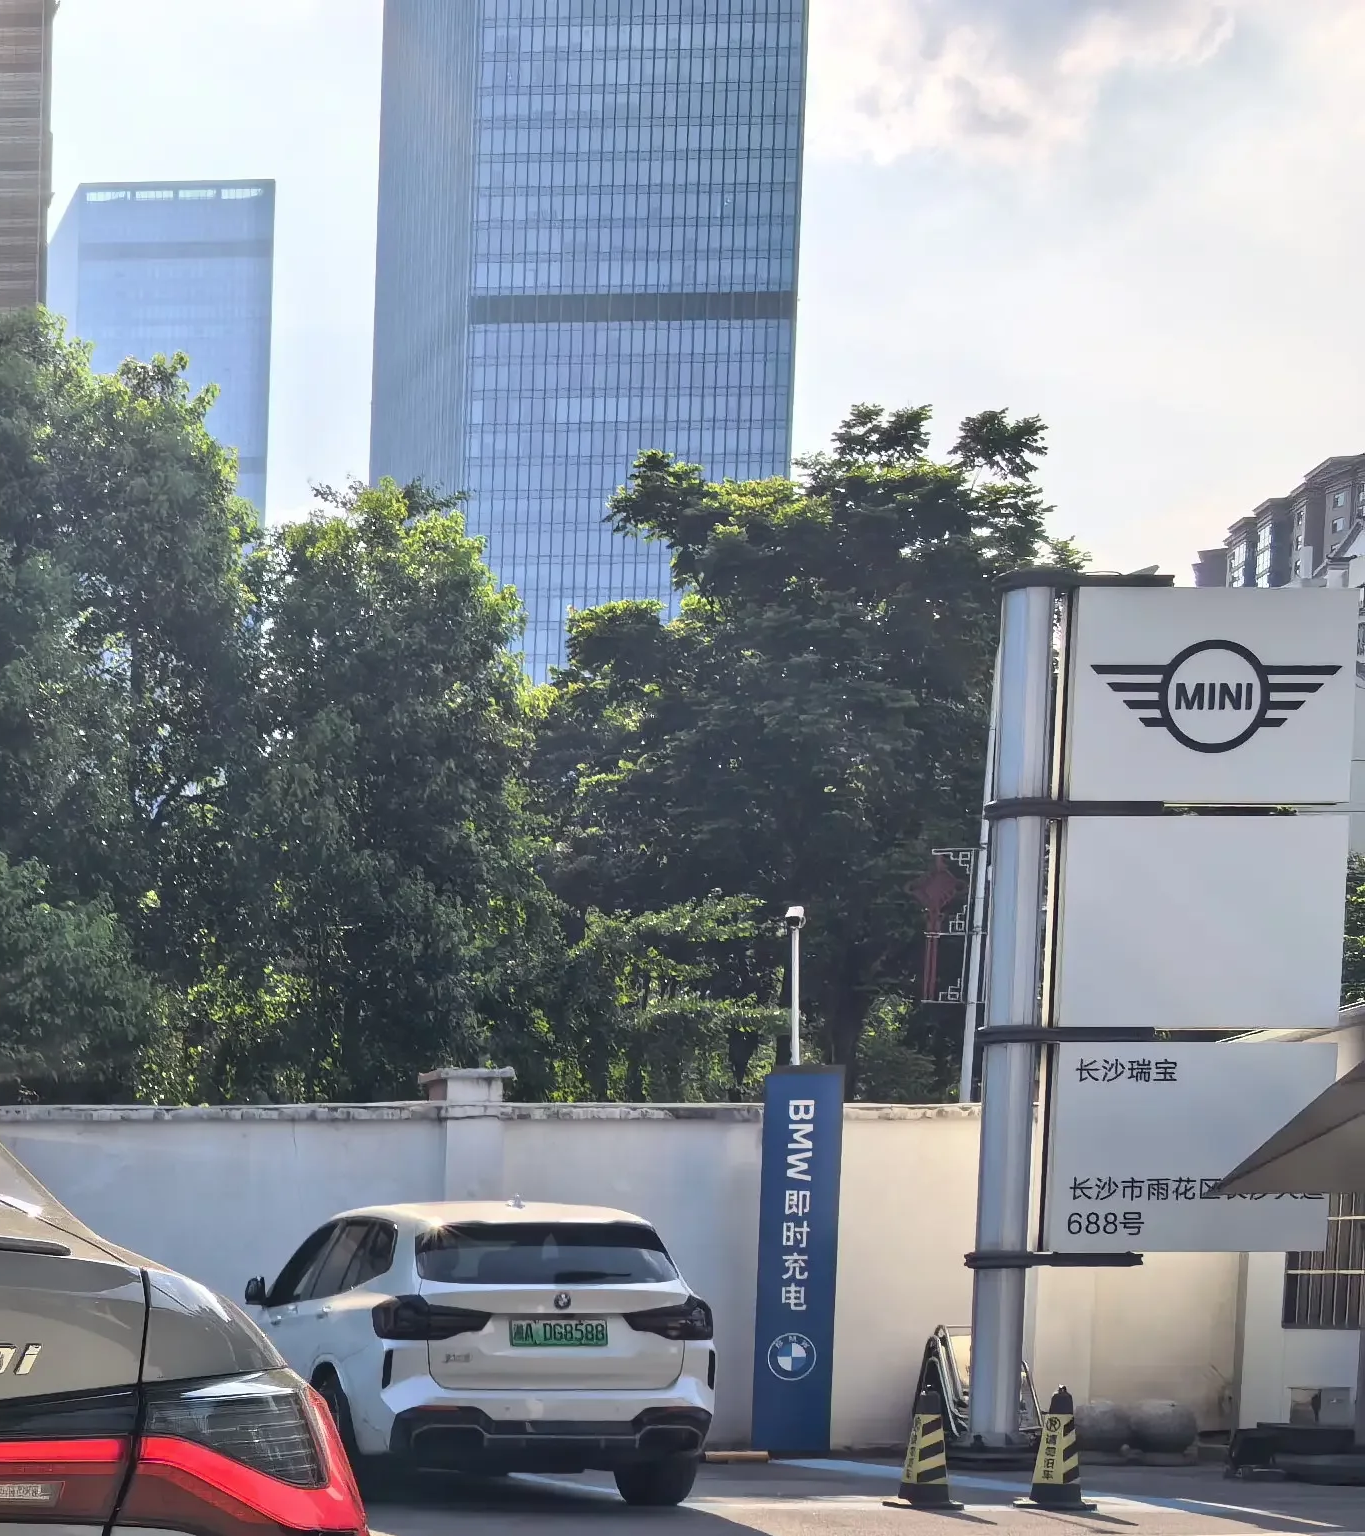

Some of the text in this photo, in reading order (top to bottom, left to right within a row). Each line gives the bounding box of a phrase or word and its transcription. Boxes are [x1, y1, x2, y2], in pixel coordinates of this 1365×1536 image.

[1174, 682, 1254, 711] MINI
[1075, 1058, 1178, 1082] 长沙瑞宝
[1069, 1176, 1325, 1201] 长沙市雨花区
[781, 1099, 815, 1311] BMW 即时充电
[1067, 1211, 1144, 1235] 688号
[774, 1335, 810, 1349] BMW
